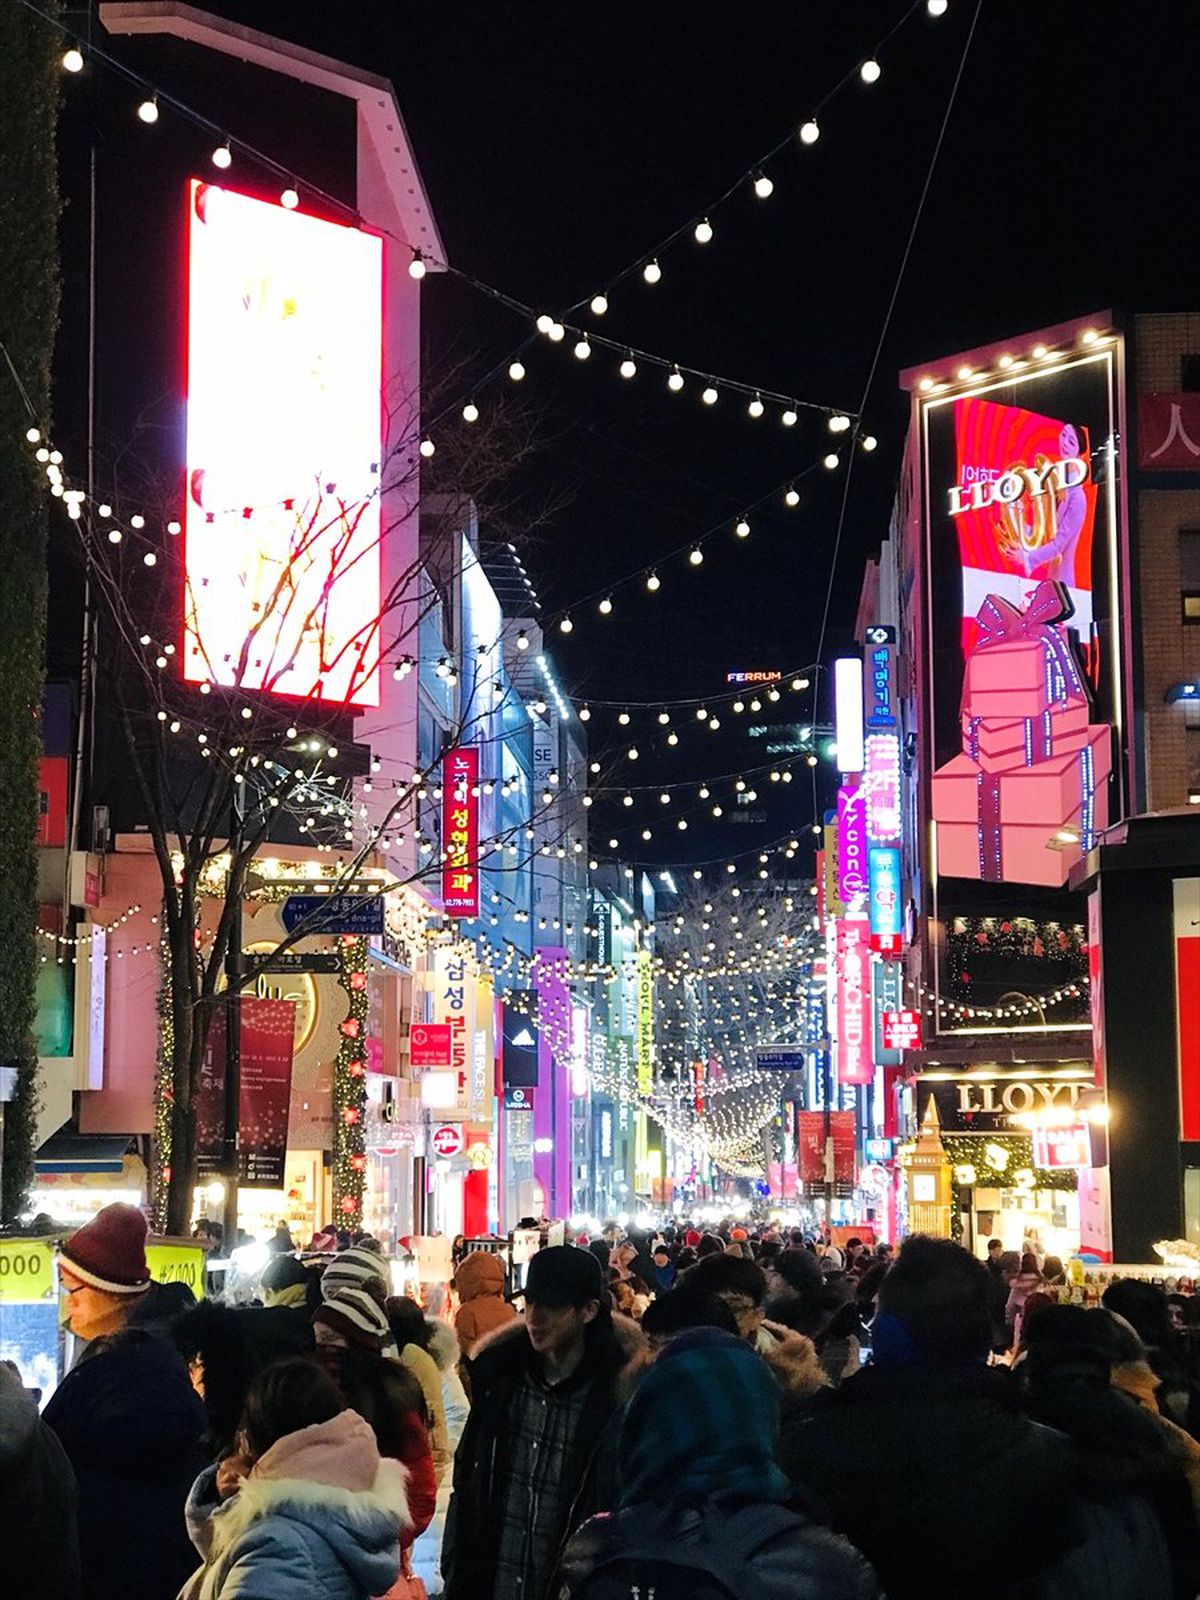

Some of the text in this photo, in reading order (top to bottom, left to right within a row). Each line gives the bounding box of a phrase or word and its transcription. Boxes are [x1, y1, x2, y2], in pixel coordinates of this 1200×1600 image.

[948, 458, 1088, 516] LLOYD
[727, 672, 782, 682] FERRUM
[844, 954, 862, 1045] ORCHID
